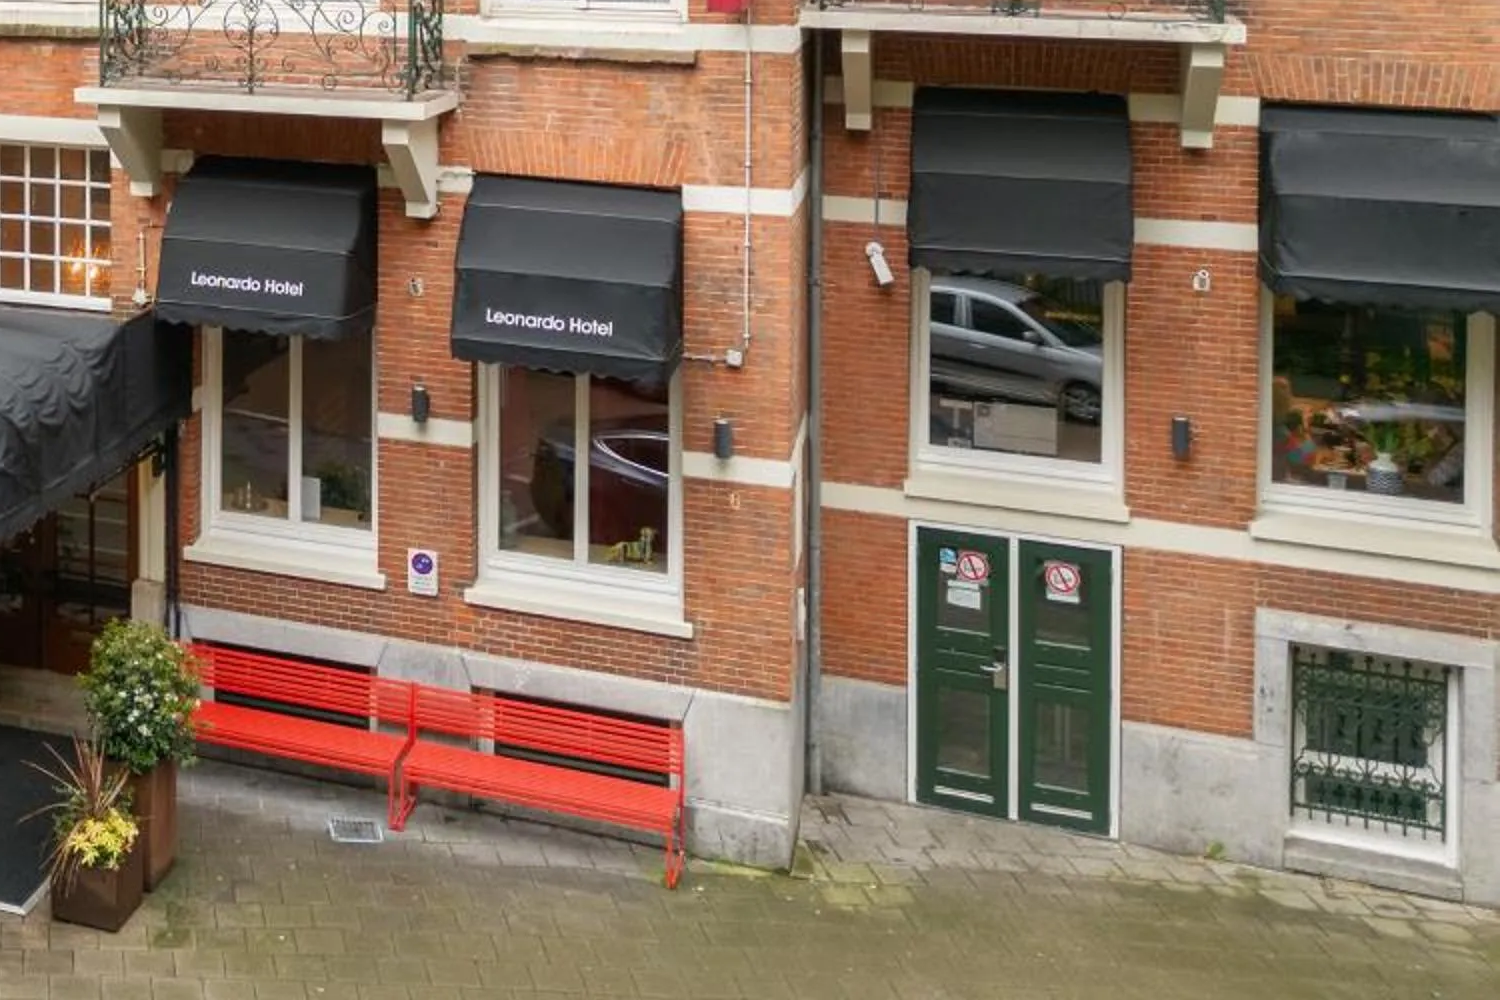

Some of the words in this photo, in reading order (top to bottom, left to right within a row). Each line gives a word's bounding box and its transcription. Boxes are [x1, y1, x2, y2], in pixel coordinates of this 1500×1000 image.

[191, 271, 261, 292] Leonardo
[264, 279, 303, 297] Hotel
[486, 307, 565, 331] Leonardo
[569, 317, 613, 337] Hotel
